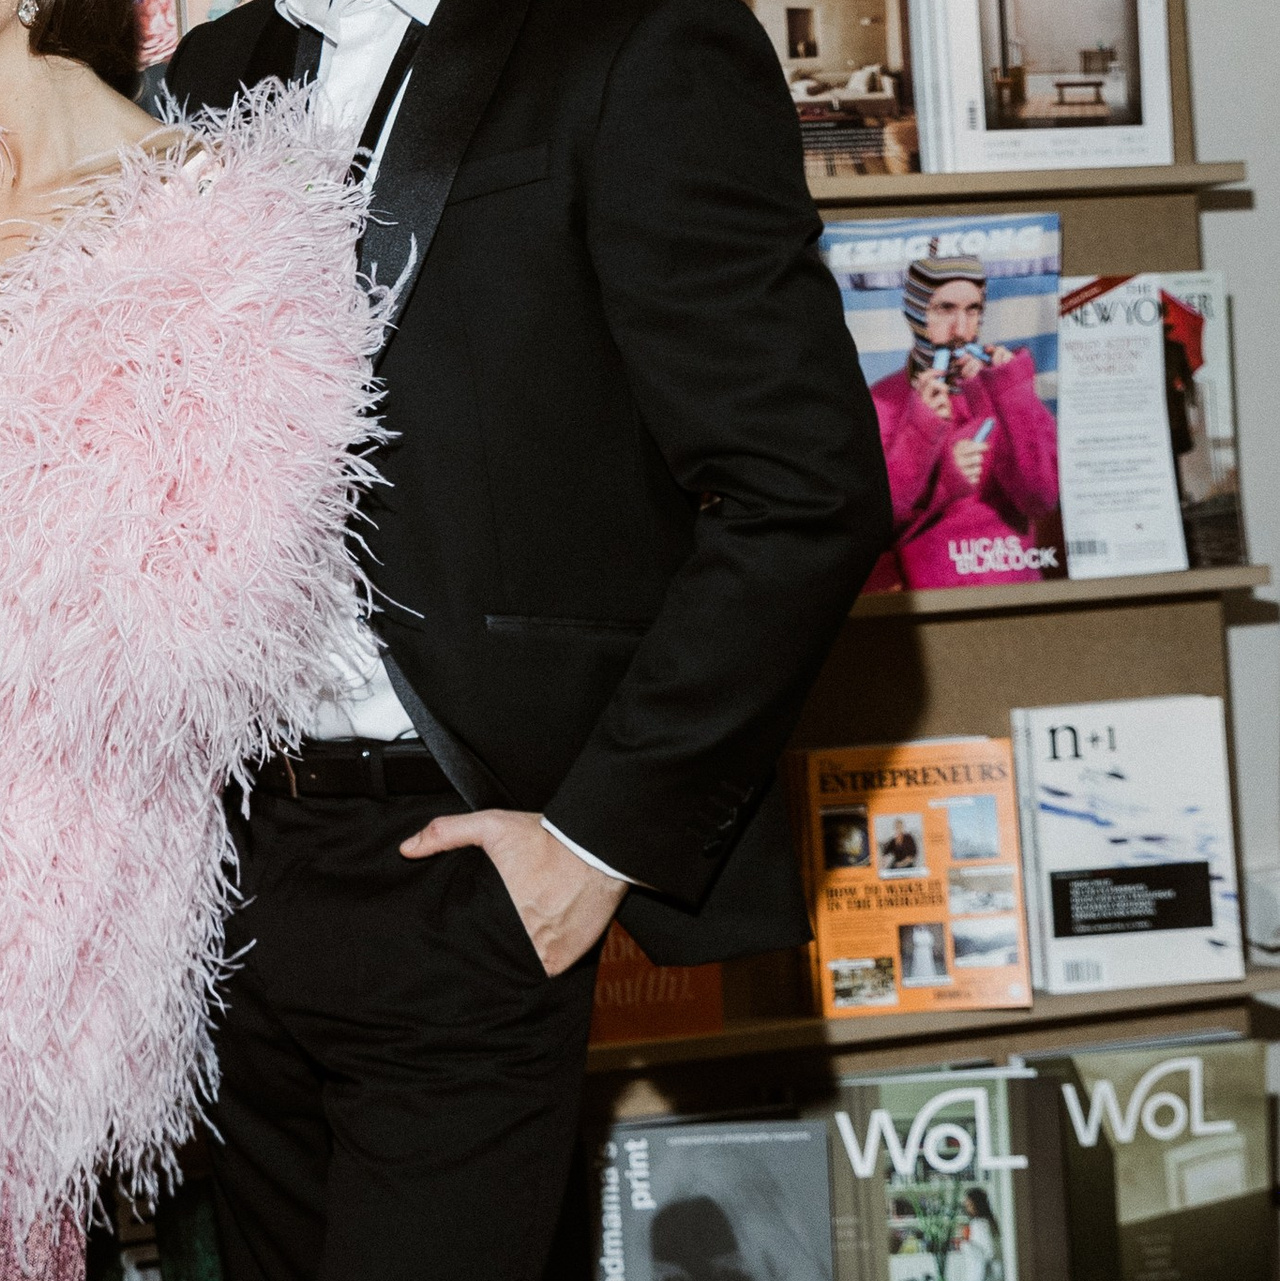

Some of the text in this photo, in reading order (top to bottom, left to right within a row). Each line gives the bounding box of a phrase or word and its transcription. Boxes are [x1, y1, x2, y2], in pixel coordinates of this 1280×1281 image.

[1046, 723, 1118, 762] n+1
[819, 763, 1008, 794] ENTREPRENEURS
[624, 1137, 657, 1210] print
